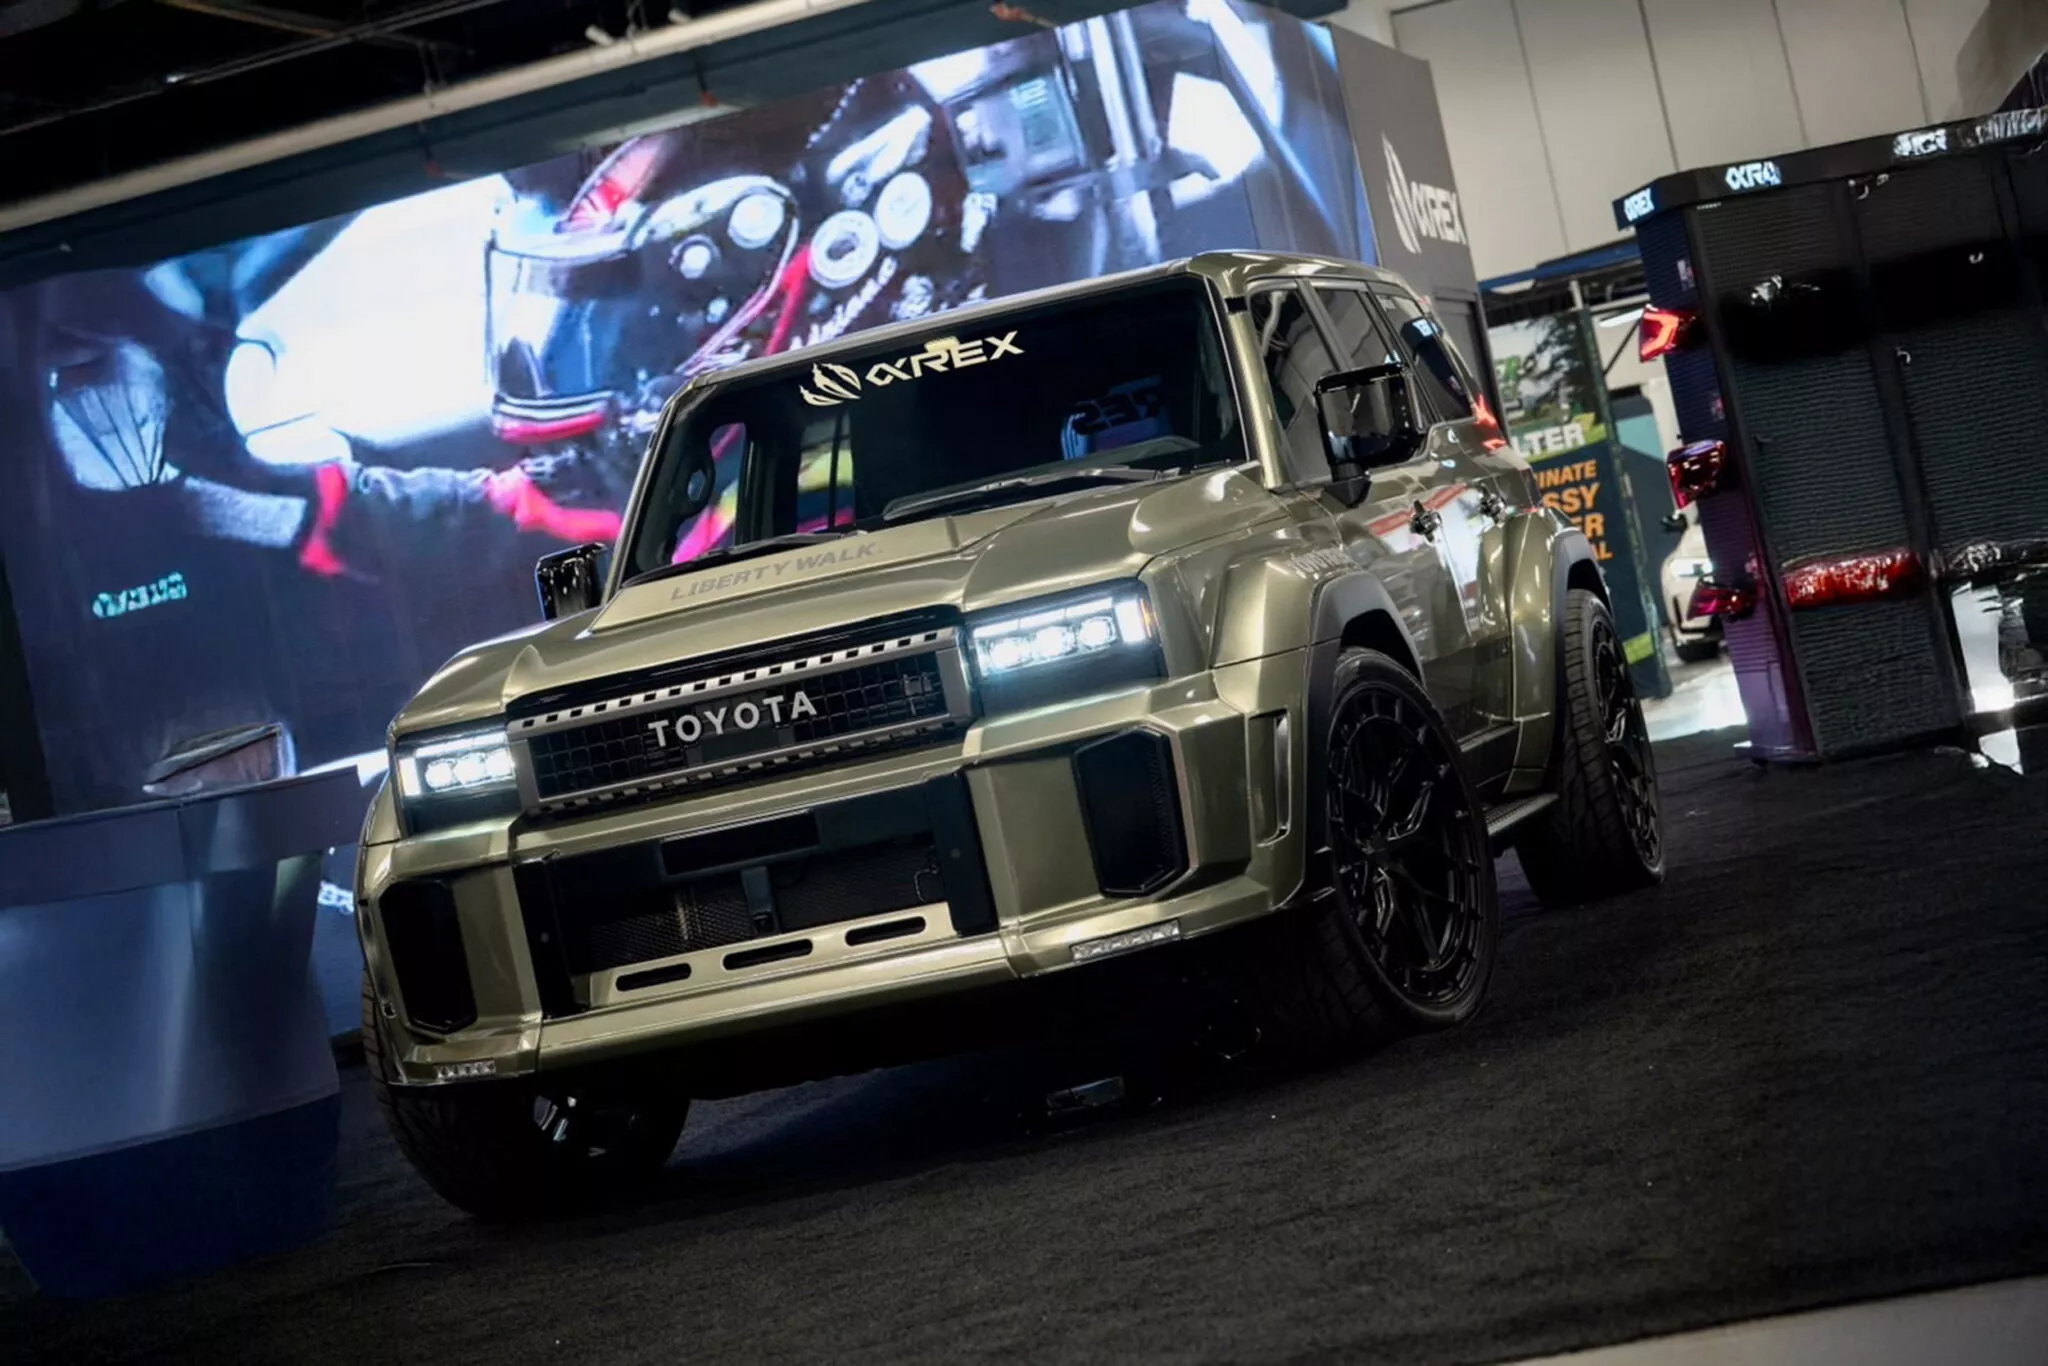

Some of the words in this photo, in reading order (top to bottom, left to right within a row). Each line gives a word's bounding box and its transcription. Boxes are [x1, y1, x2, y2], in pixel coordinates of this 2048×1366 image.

[1512, 422, 1585, 458] LTER
[1534, 460, 1597, 488] INATE
[1543, 483, 1599, 513] SSY
[671, 561, 791, 600] LIBERTY
[648, 691, 817, 747] TOYOTA
